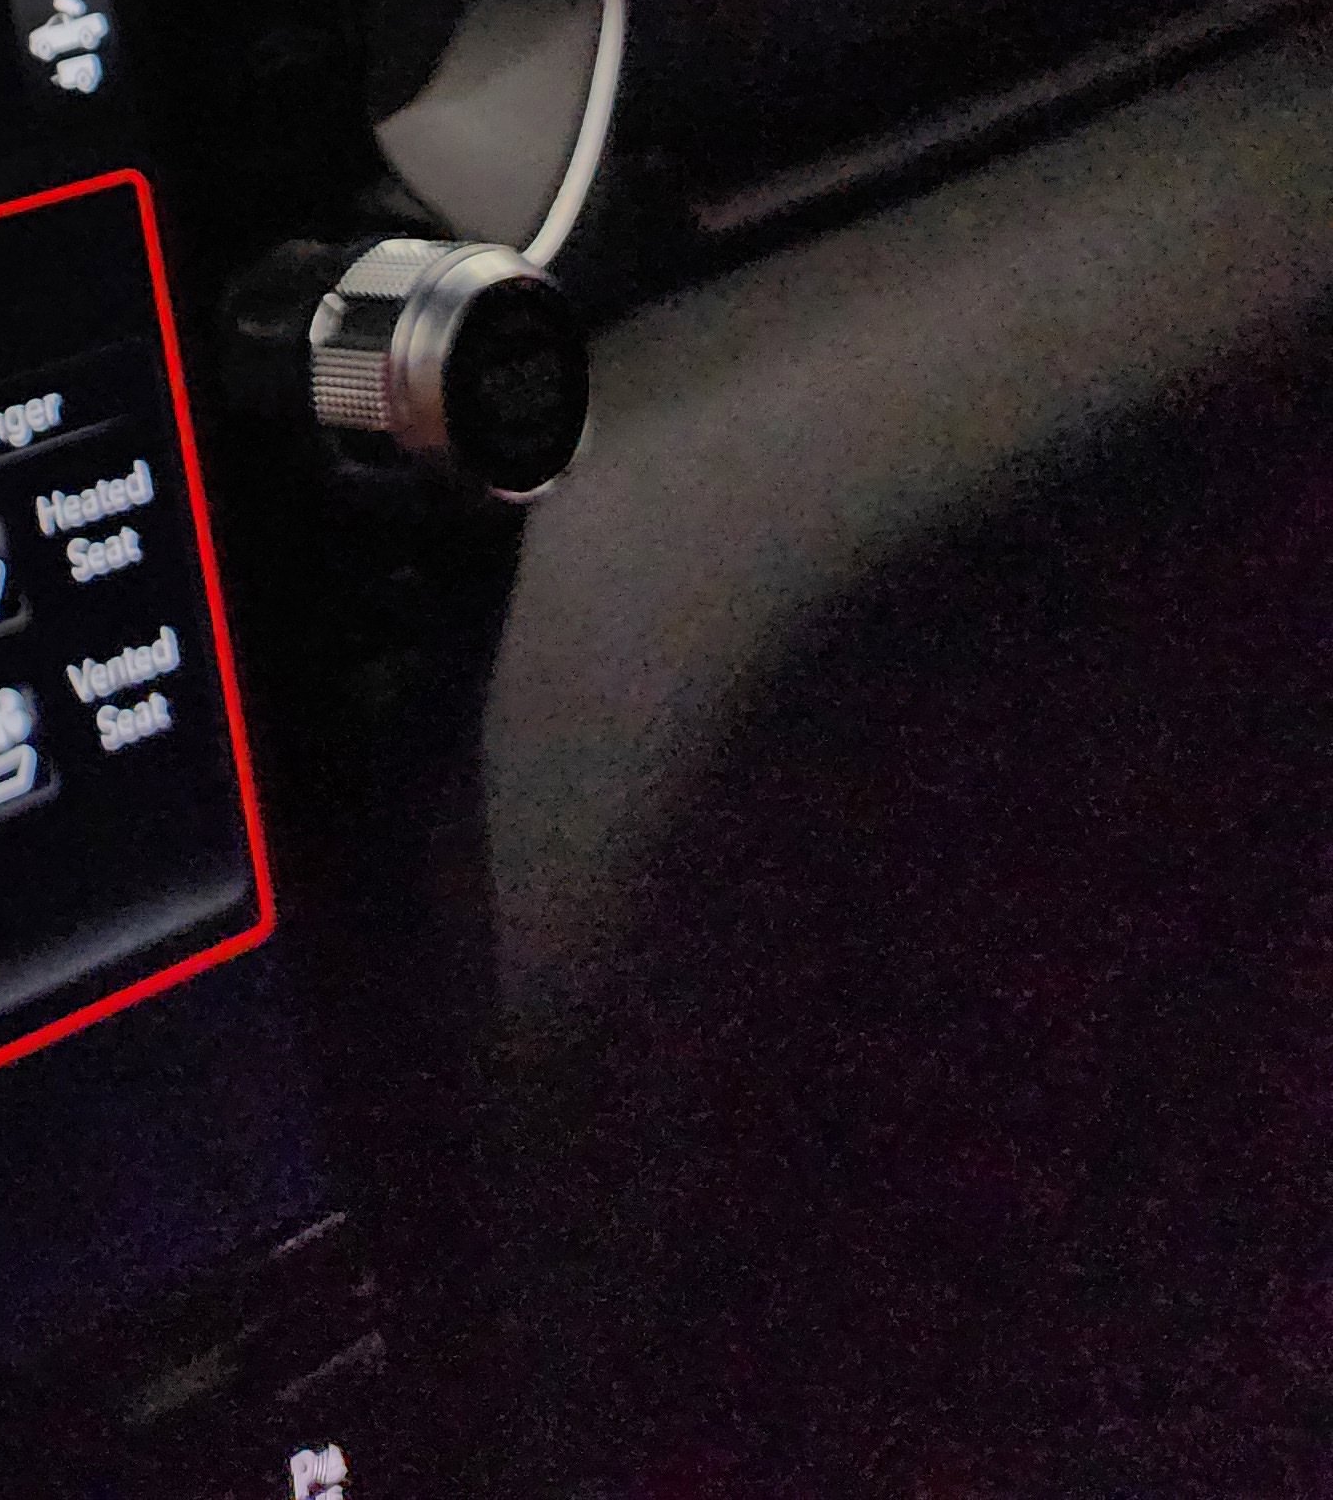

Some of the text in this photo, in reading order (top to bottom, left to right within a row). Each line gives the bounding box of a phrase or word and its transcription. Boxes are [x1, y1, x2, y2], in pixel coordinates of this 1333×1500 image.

[36, 459, 155, 538] Heated
[66, 526, 143, 583] Seat
[66, 624, 182, 703] Vented
[96, 691, 174, 753] Seat
